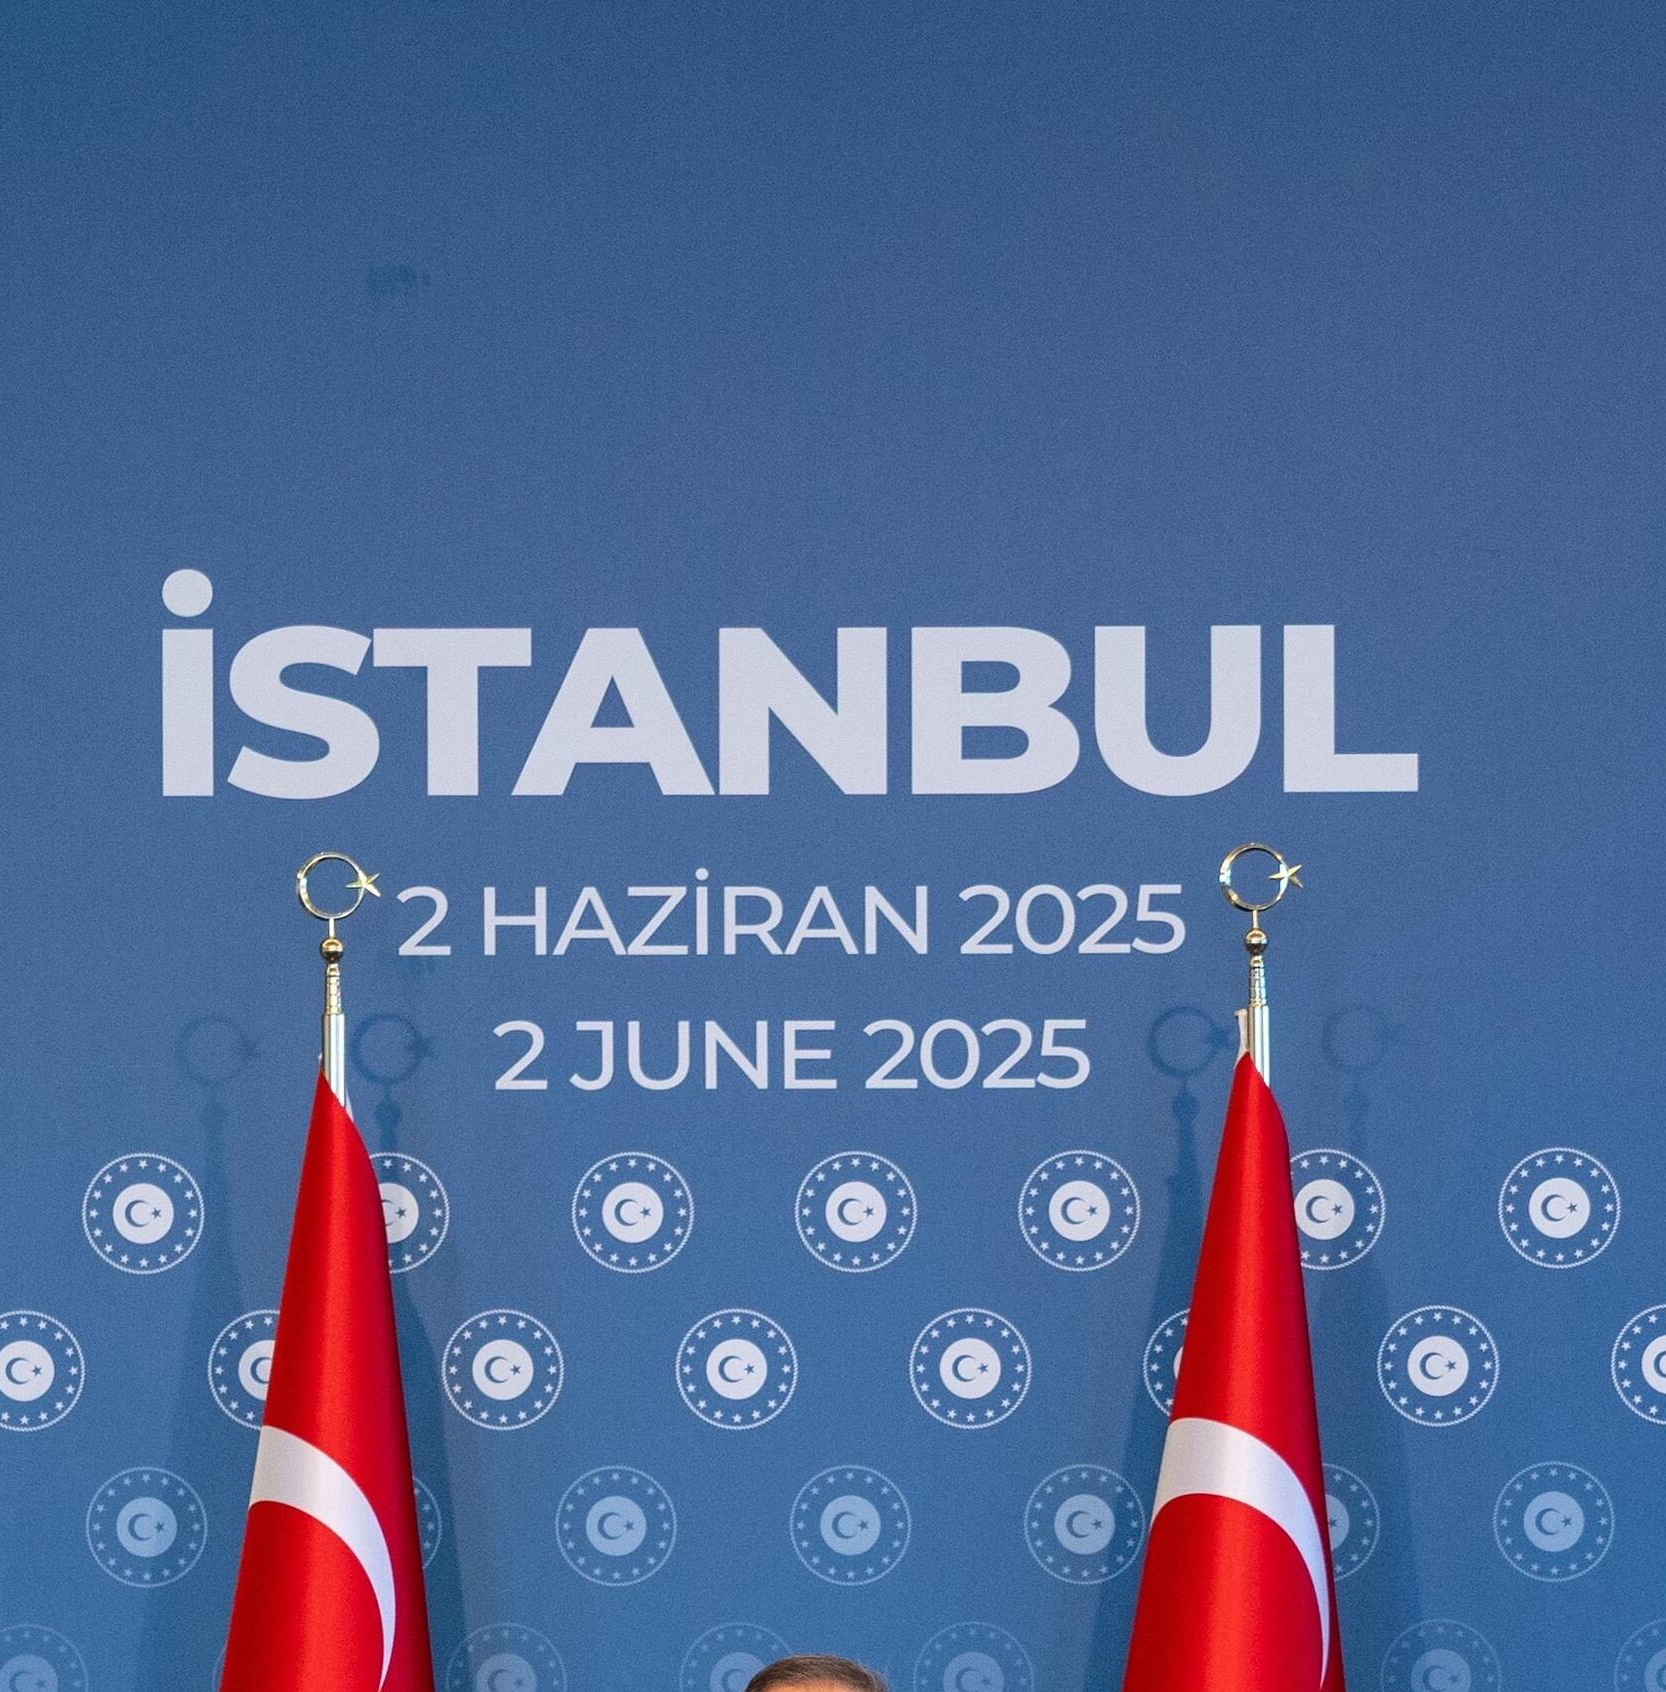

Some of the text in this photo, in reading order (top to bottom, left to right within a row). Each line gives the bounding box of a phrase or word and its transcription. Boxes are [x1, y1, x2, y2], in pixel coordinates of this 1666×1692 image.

[162, 569, 1419, 800] İSTANBUL
[397, 867, 1186, 956] 2 HAZİRAN 2025
[494, 1019, 1091, 1090] 2 JUNE 2025
